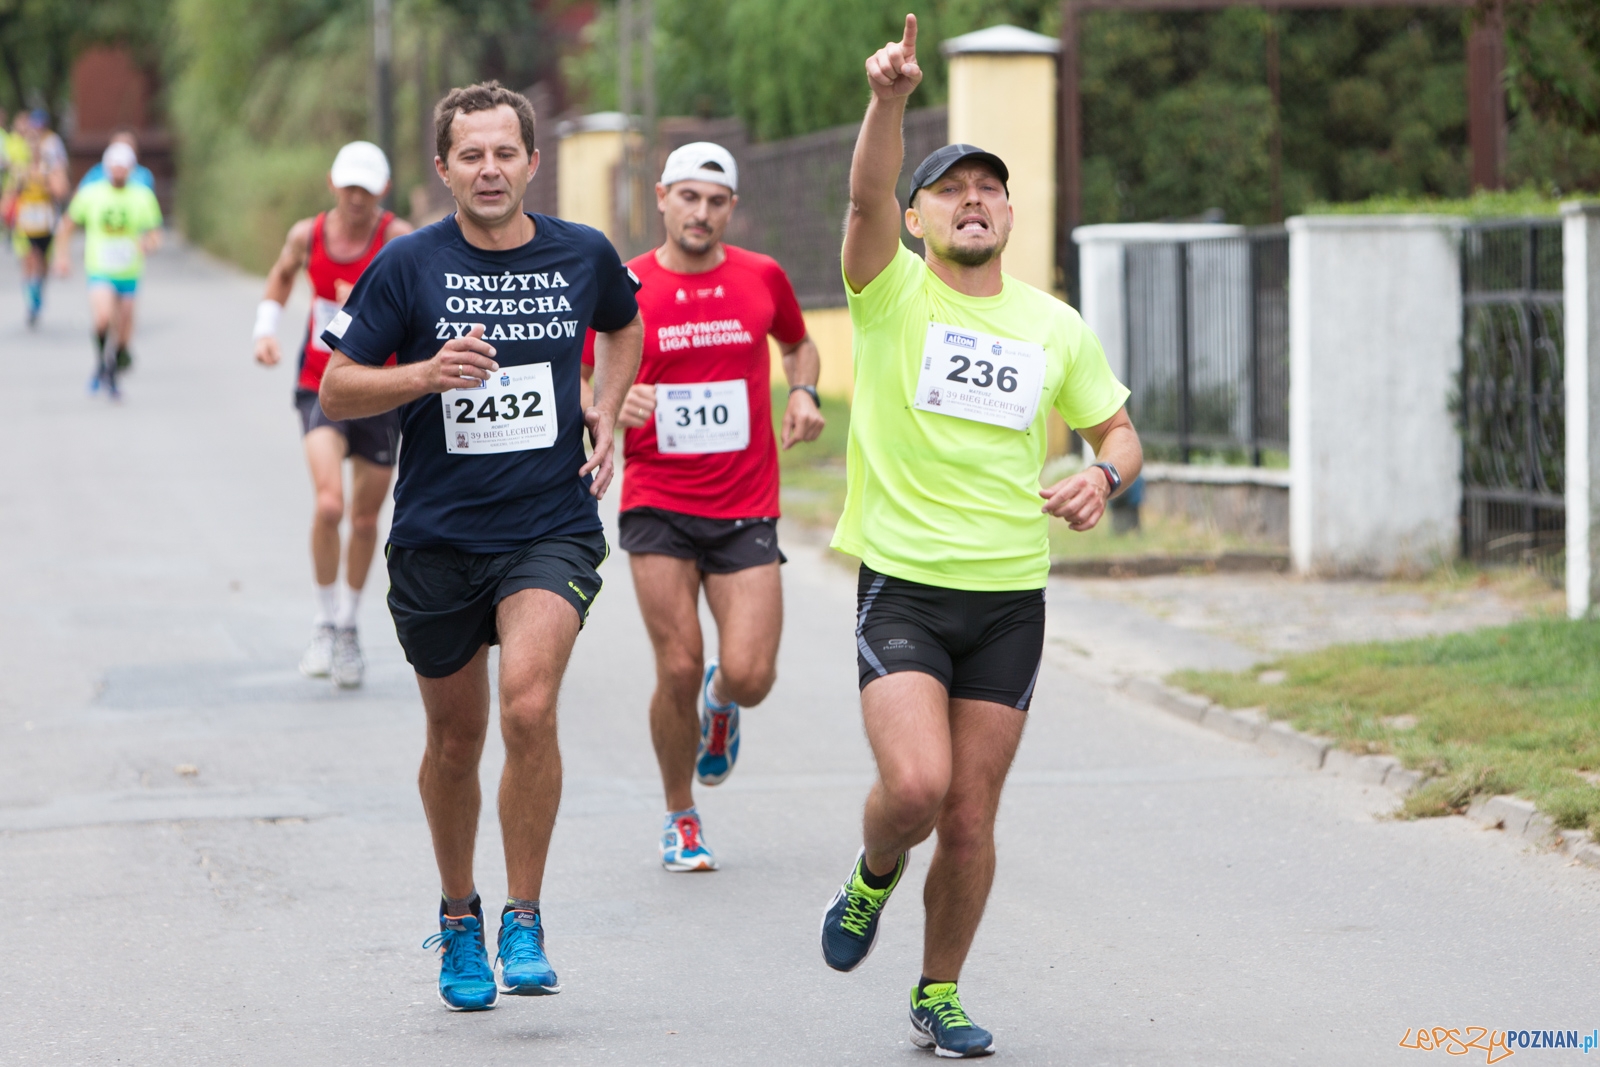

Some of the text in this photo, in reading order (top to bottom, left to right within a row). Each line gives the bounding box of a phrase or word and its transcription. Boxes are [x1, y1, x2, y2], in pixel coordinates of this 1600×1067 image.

[444, 271, 569, 291] DRUŻYNA
[445, 295, 572, 315] ORZECHA
[657, 319, 743, 339] DRUŻYNOWA
[659, 330, 752, 352] LIGA BIEGOWA
[946, 354, 1019, 393] 236
[454, 390, 544, 423] 2432
[946, 390, 958, 399] 39
[959, 393, 980, 404] BIEG
[675, 404, 728, 427] 310
[470, 431, 481, 440] 39
[483, 429, 504, 439] BIEG
